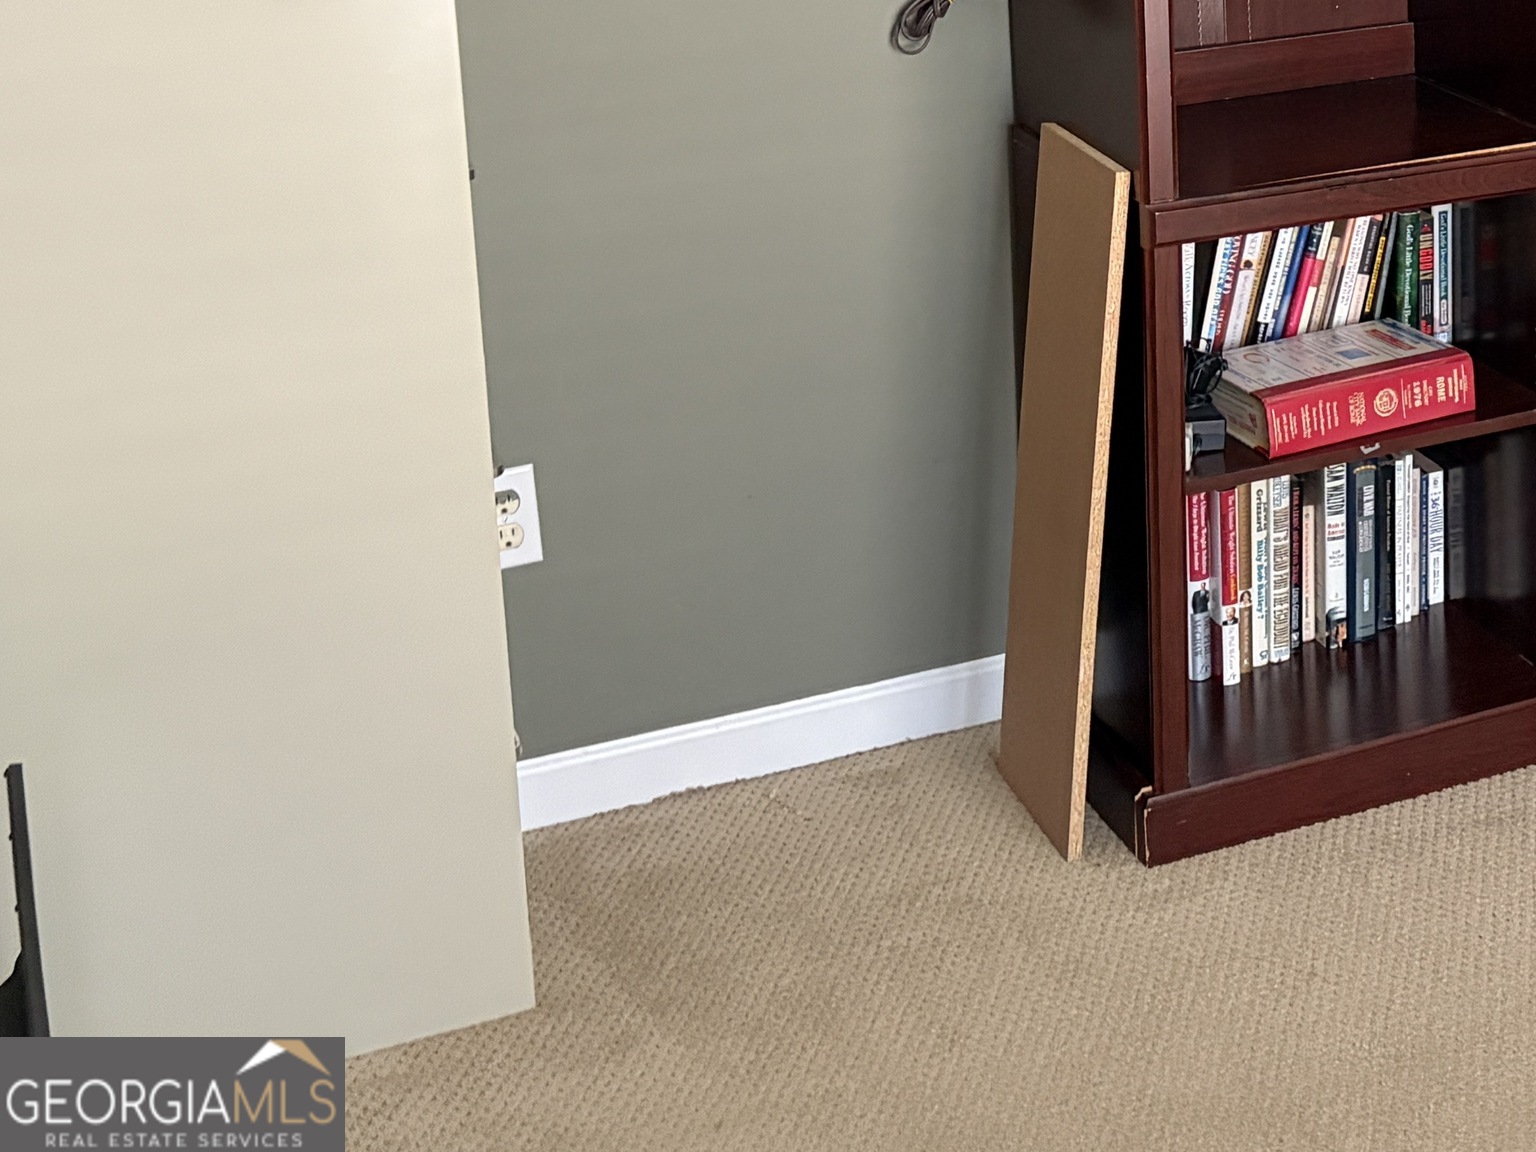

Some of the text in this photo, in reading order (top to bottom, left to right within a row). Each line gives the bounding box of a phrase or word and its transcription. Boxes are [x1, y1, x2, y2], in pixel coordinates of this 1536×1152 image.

[1405, 224, 1414, 245] God's
[1405, 246, 1413, 267] Little
[1419, 233, 1433, 280] UNGODLY
[1403, 268, 1412, 308] Devotional
[1326, 464, 1344, 482] SAM
[1255, 488, 1263, 532] Grizzard
[1326, 483, 1344, 516] WALTON
[1254, 539, 1263, 562] Billy
[1255, 583, 1264, 613] Bailey
